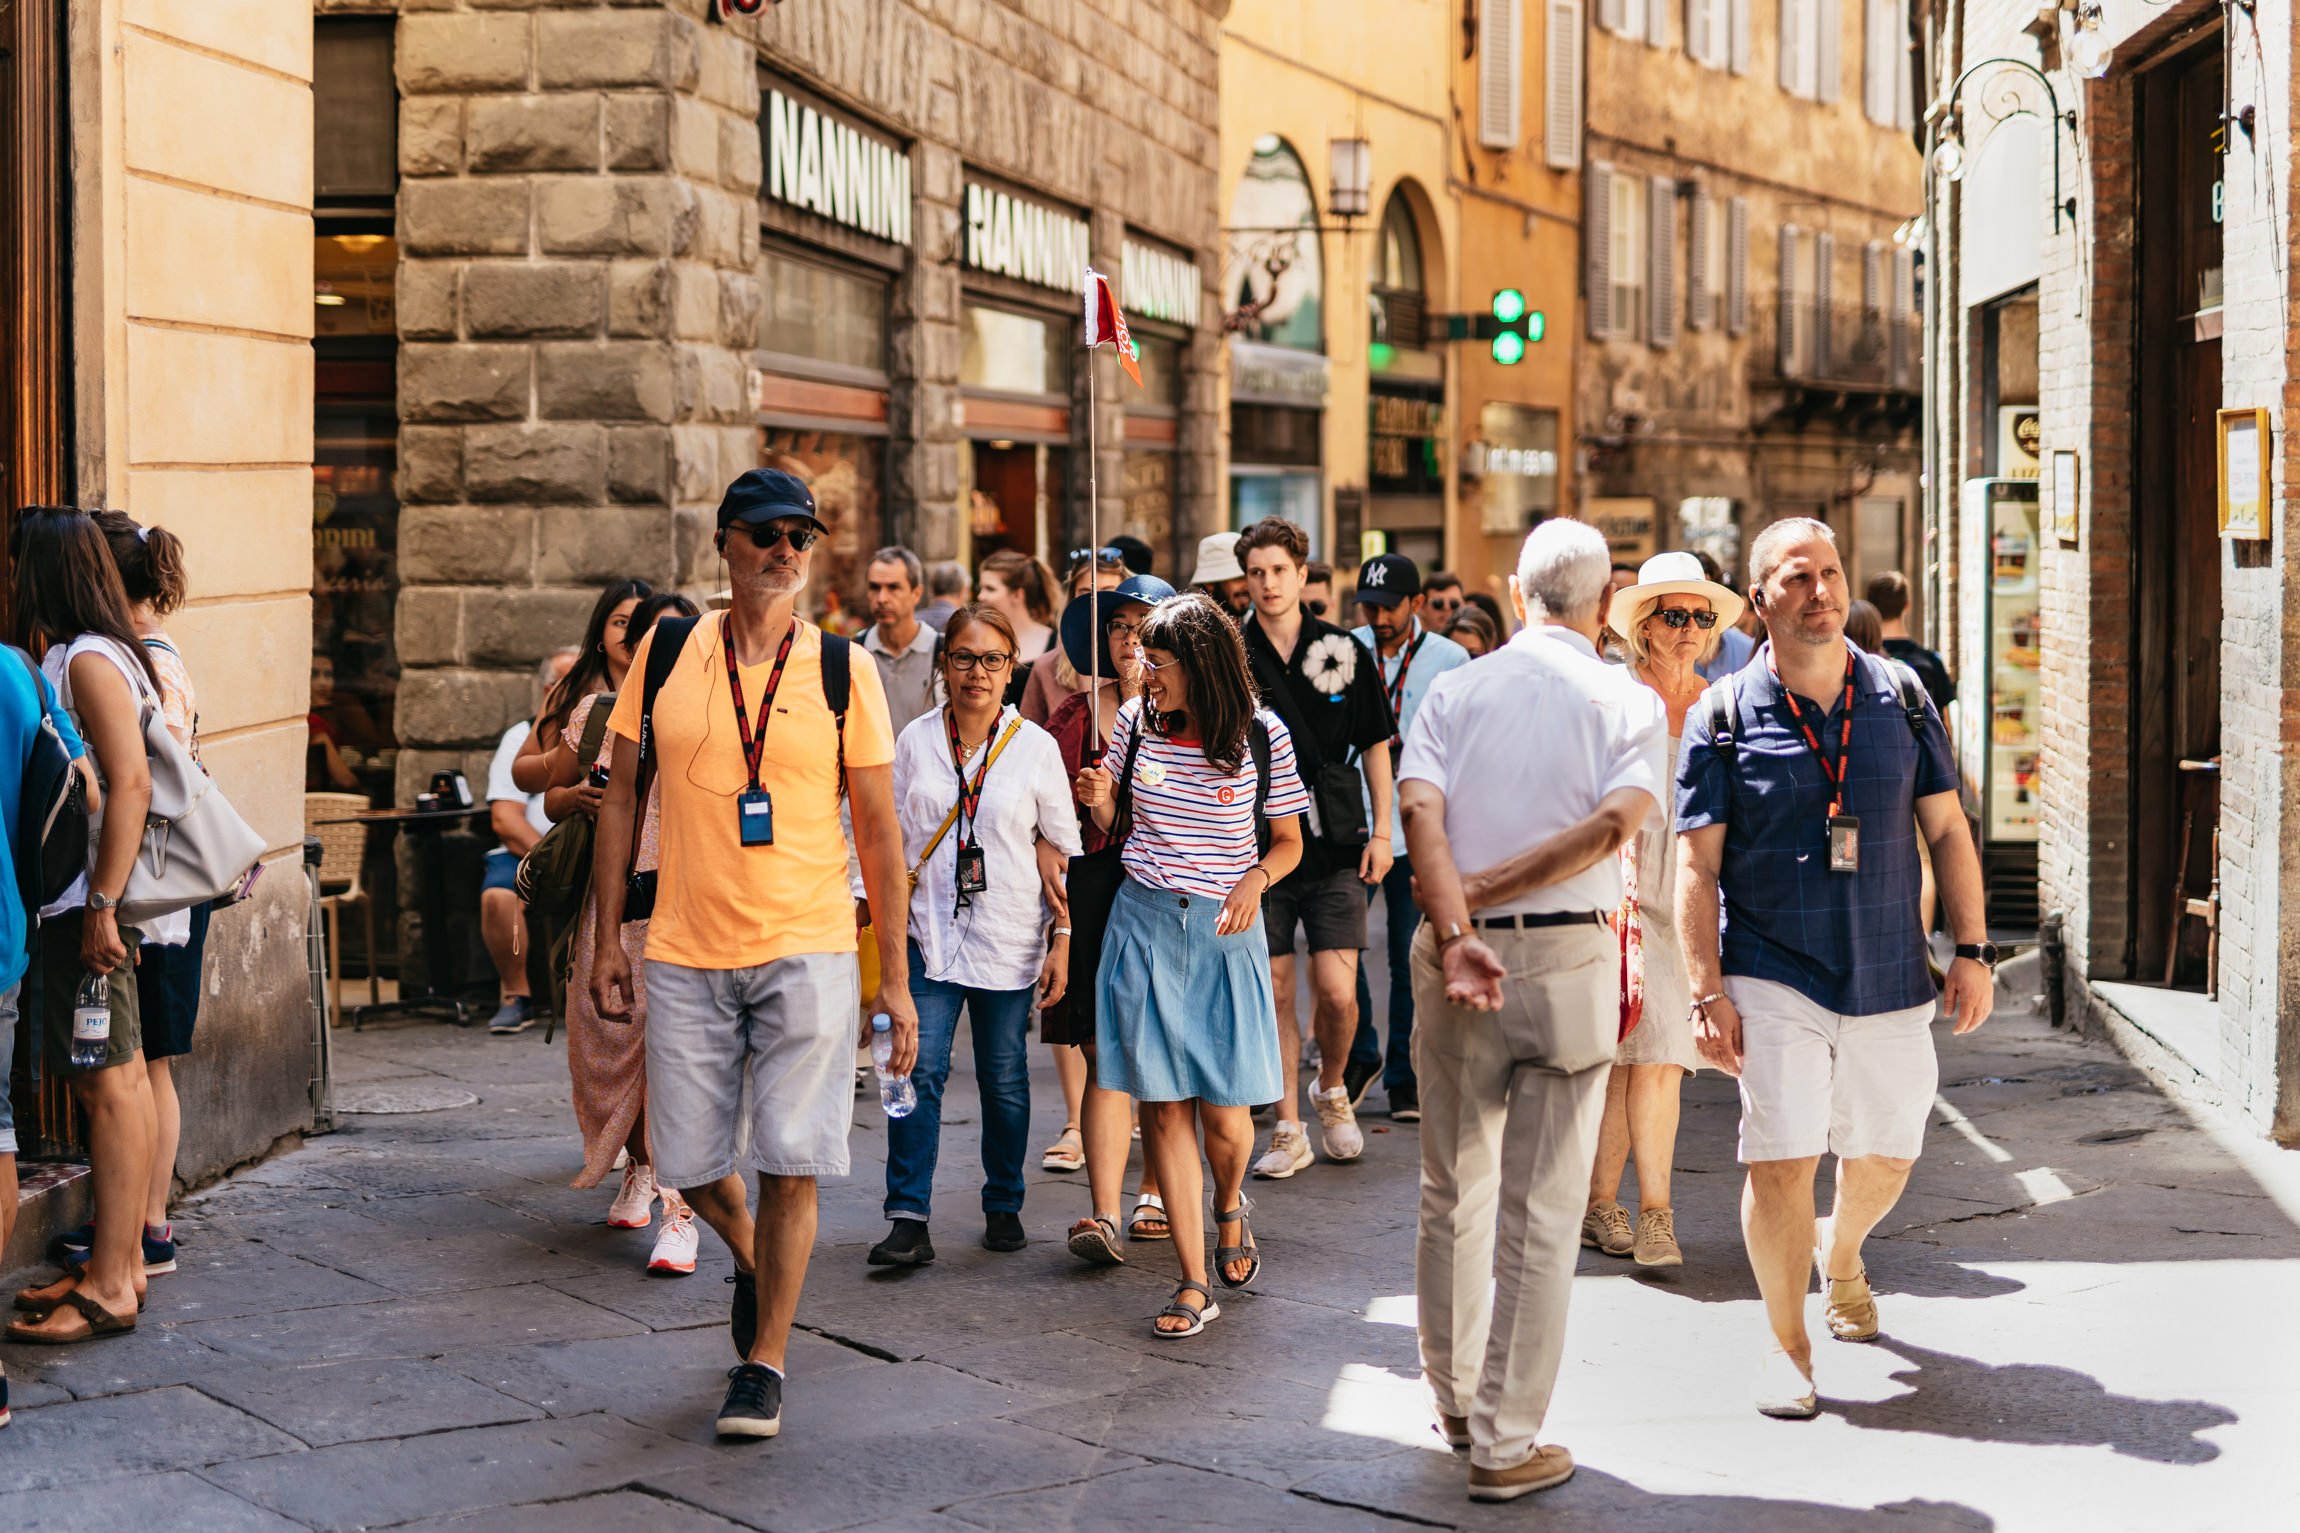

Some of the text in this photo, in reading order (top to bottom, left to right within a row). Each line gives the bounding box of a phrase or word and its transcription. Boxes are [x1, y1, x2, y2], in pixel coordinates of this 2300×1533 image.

[770, 88, 912, 246] NANNINI
[968, 183, 1090, 295] NANNINI
[640, 714, 650, 760] LUMIX
